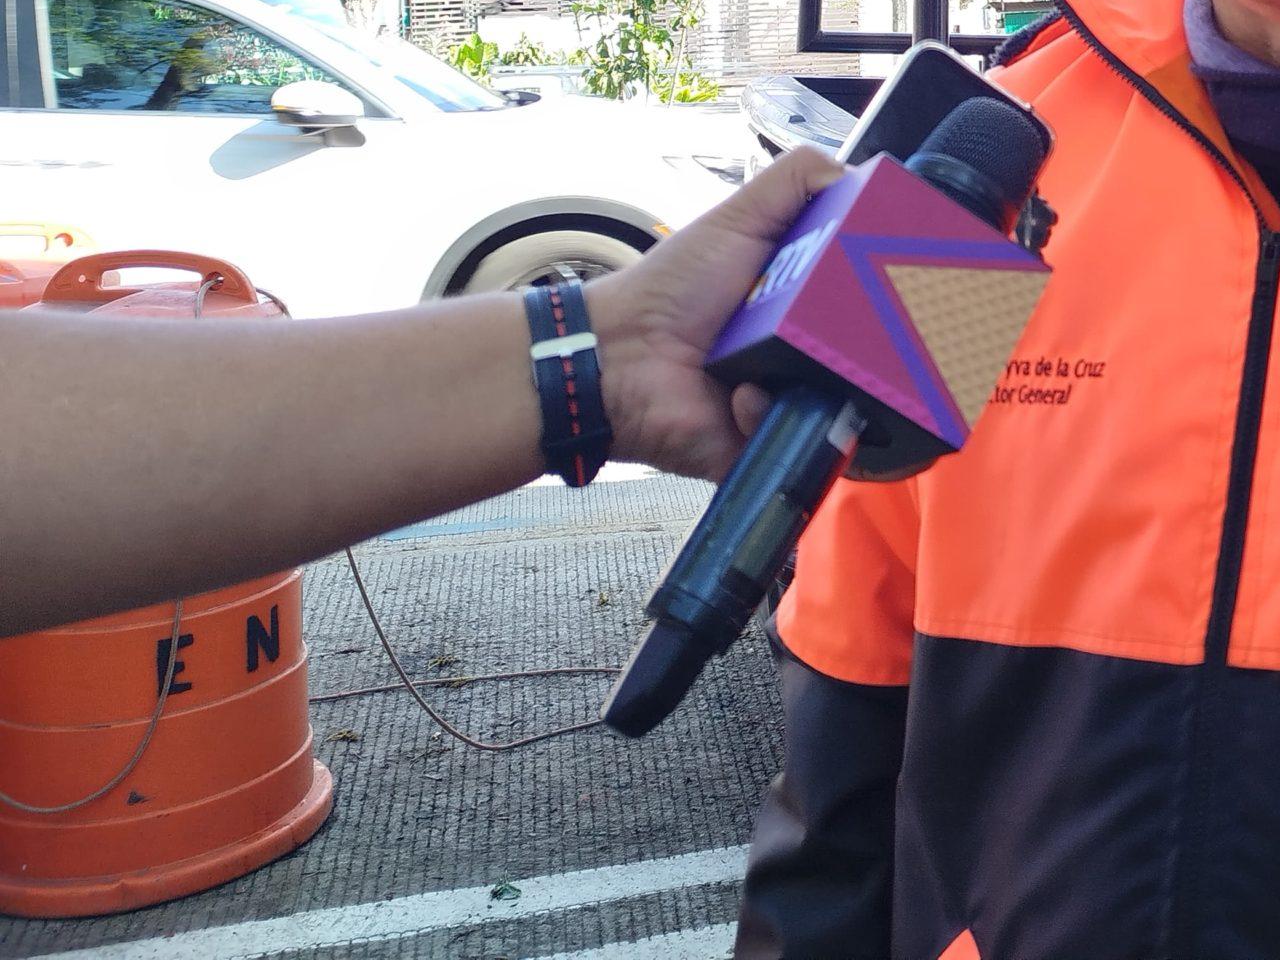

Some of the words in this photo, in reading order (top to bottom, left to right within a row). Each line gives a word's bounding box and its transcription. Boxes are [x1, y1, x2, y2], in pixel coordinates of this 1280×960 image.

[1034, 355, 1052, 377] de
[1056, 356, 1070, 377] la
[1074, 358, 1106, 378] Cruz
[1018, 383, 1073, 405] General
